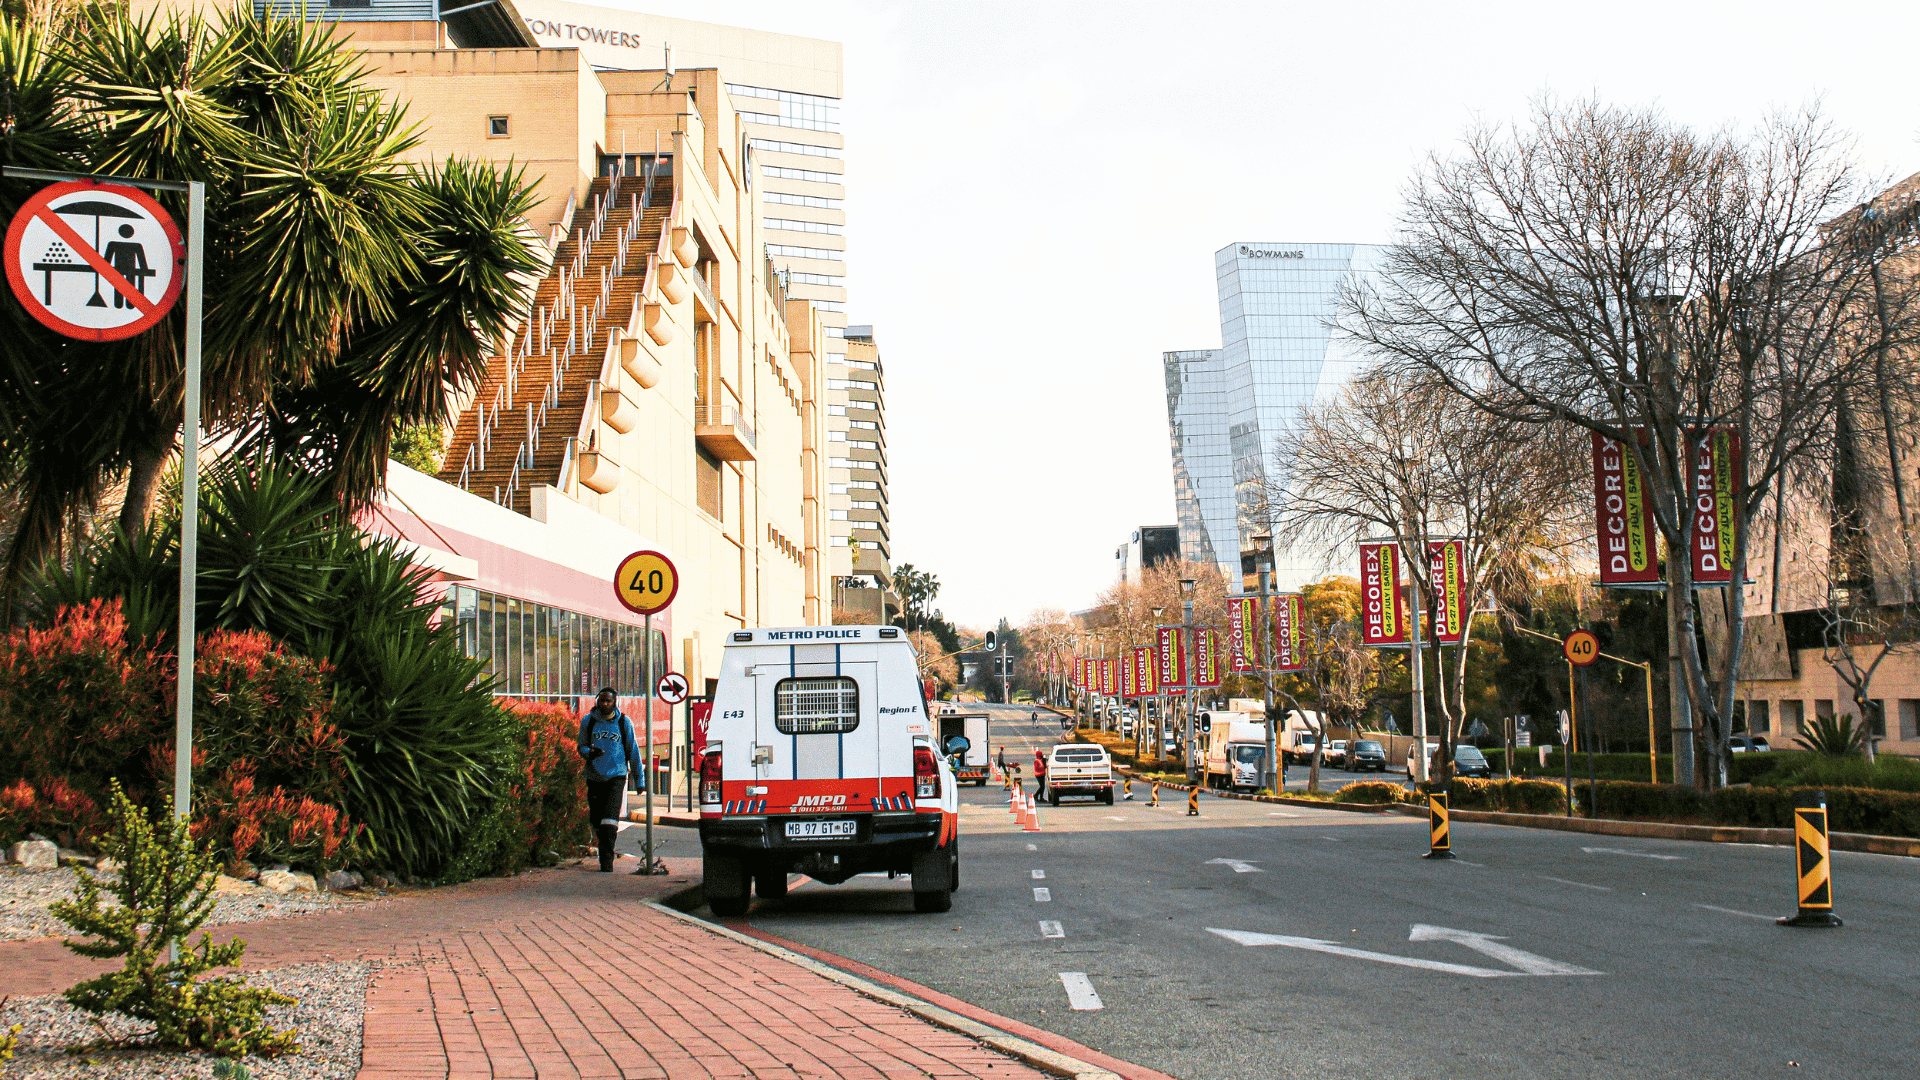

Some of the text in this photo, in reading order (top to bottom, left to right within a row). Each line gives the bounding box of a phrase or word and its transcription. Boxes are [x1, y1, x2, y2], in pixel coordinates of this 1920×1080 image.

[525, 18, 640, 49] ON TOWERS
[1249, 249, 1304, 259] BOWMANS
[1602, 436, 1628, 573] DECOREX
[1626, 445, 1643, 566] 24-27 JULY SANDT
[1697, 434, 1718, 571] DECOREX
[1720, 502, 1729, 528] JULY
[629, 570, 663, 594] 40
[1382, 549, 1390, 586] SANDTON
[1366, 549, 1382, 638] DECOREX
[768, 629, 861, 640] METRO POLICE
[1232, 601, 1244, 667] DECOREX
[1280, 600, 1290, 666] DECOREX
[1573, 640, 1592, 655] 40
[1138, 650, 1147, 693] DECOREX
[1162, 630, 1170, 683] DECOREX
[1199, 630, 1207, 683] DECOREX
[723, 710, 744, 719] E 43
[880, 706, 910, 715] Region
[791, 795, 847, 806] JMPD
[805, 823, 817, 834] 97
[822, 822, 833, 834] GT
[842, 822, 854, 834] GP
